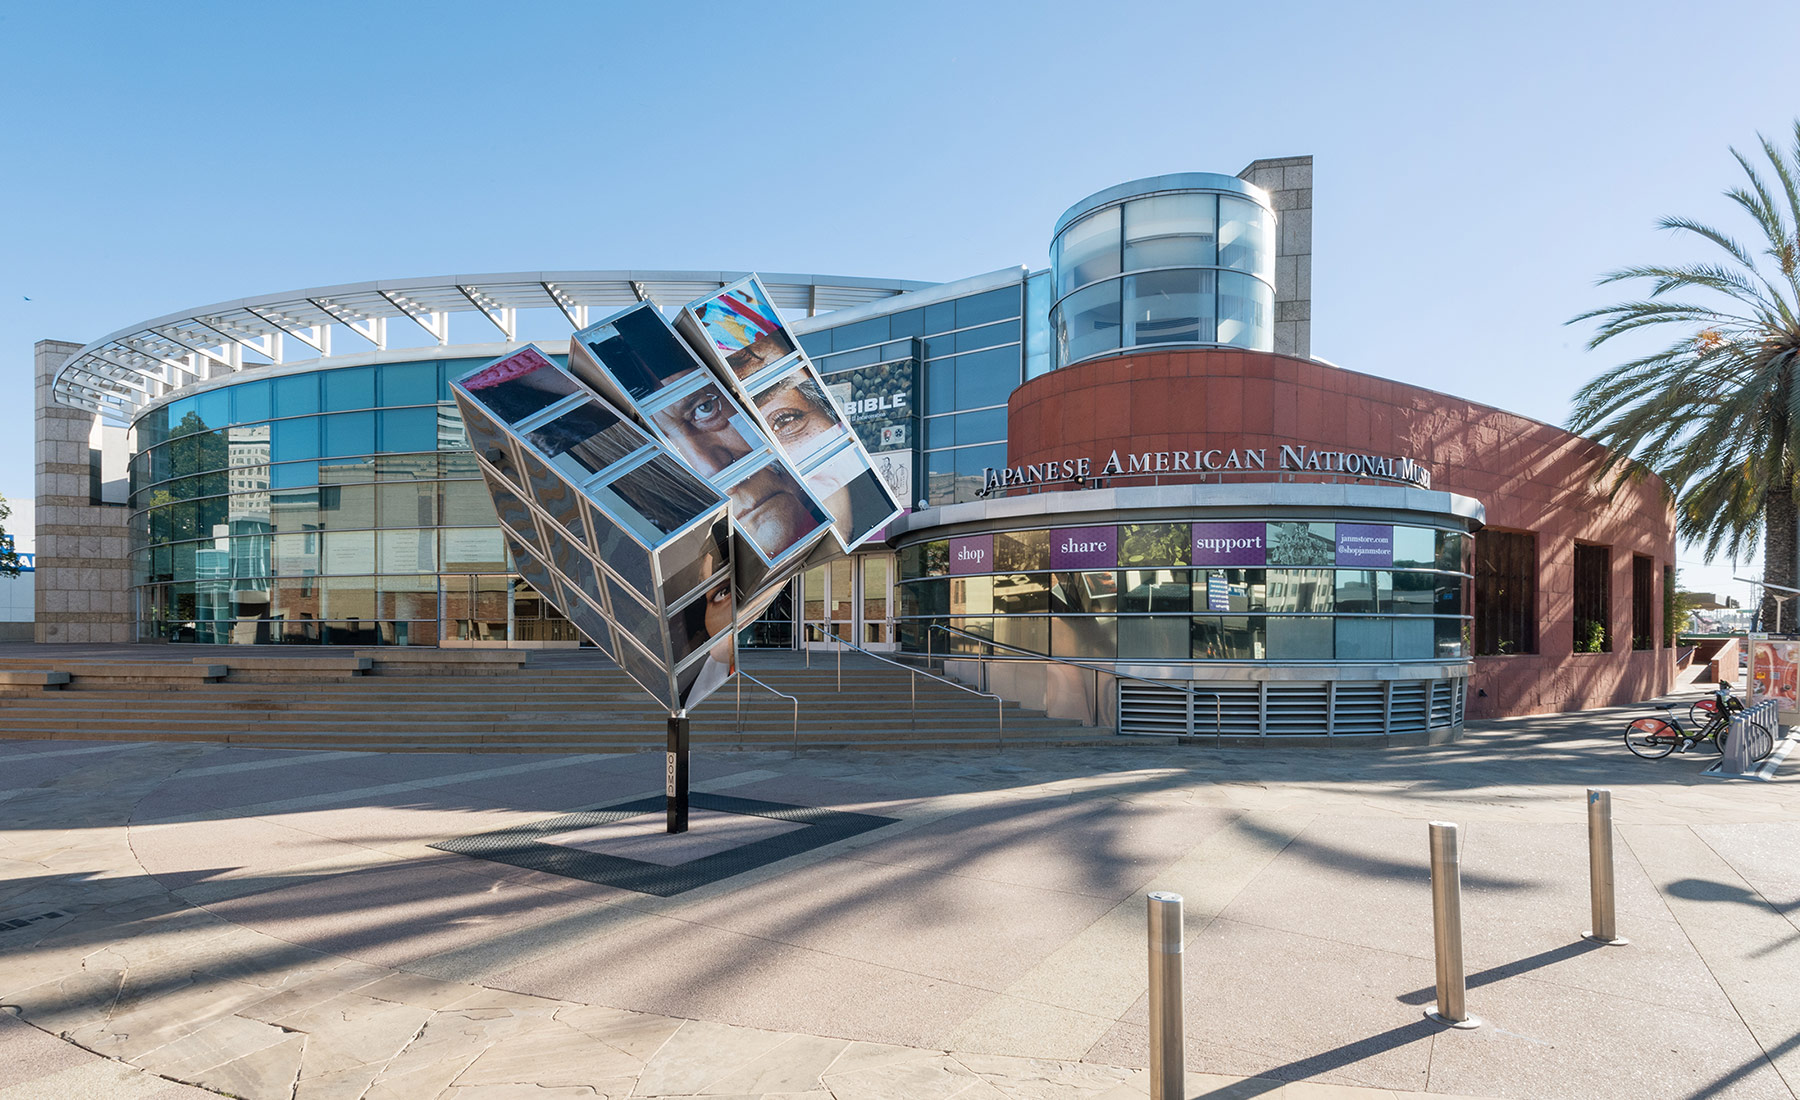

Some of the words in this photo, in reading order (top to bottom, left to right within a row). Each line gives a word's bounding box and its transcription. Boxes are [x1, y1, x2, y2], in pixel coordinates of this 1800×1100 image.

[844, 392, 907, 416] BIBLE
[978, 457, 1090, 497] JAPANESE
[1101, 449, 1267, 475] AMERICAN
[1280, 444, 1398, 477] NATIONAL
[1060, 538, 1107, 554] share
[1196, 535, 1262, 553] support
[1340, 533, 1389, 544] janmstore.com
[957, 546, 984, 563] shop
[1338, 544, 1391, 556] @shopjanmstore
